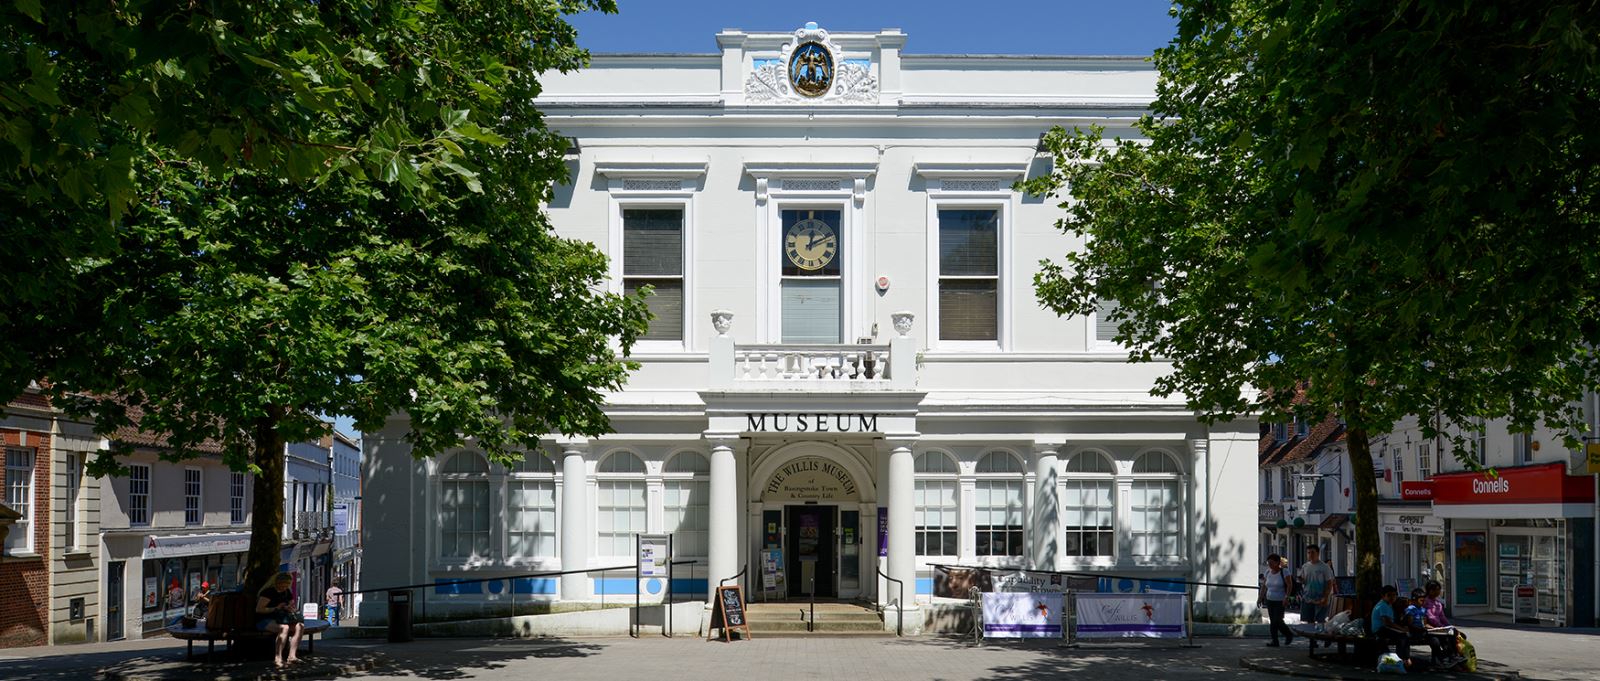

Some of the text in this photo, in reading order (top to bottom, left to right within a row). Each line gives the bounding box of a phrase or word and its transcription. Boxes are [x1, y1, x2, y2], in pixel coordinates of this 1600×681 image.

[746, 413, 879, 432] MUSEUM
[767, 461, 856, 495] THE WILLIS MUSEUM
[1473, 477, 1509, 494] Connells
[1404, 488, 1432, 496] Connells
